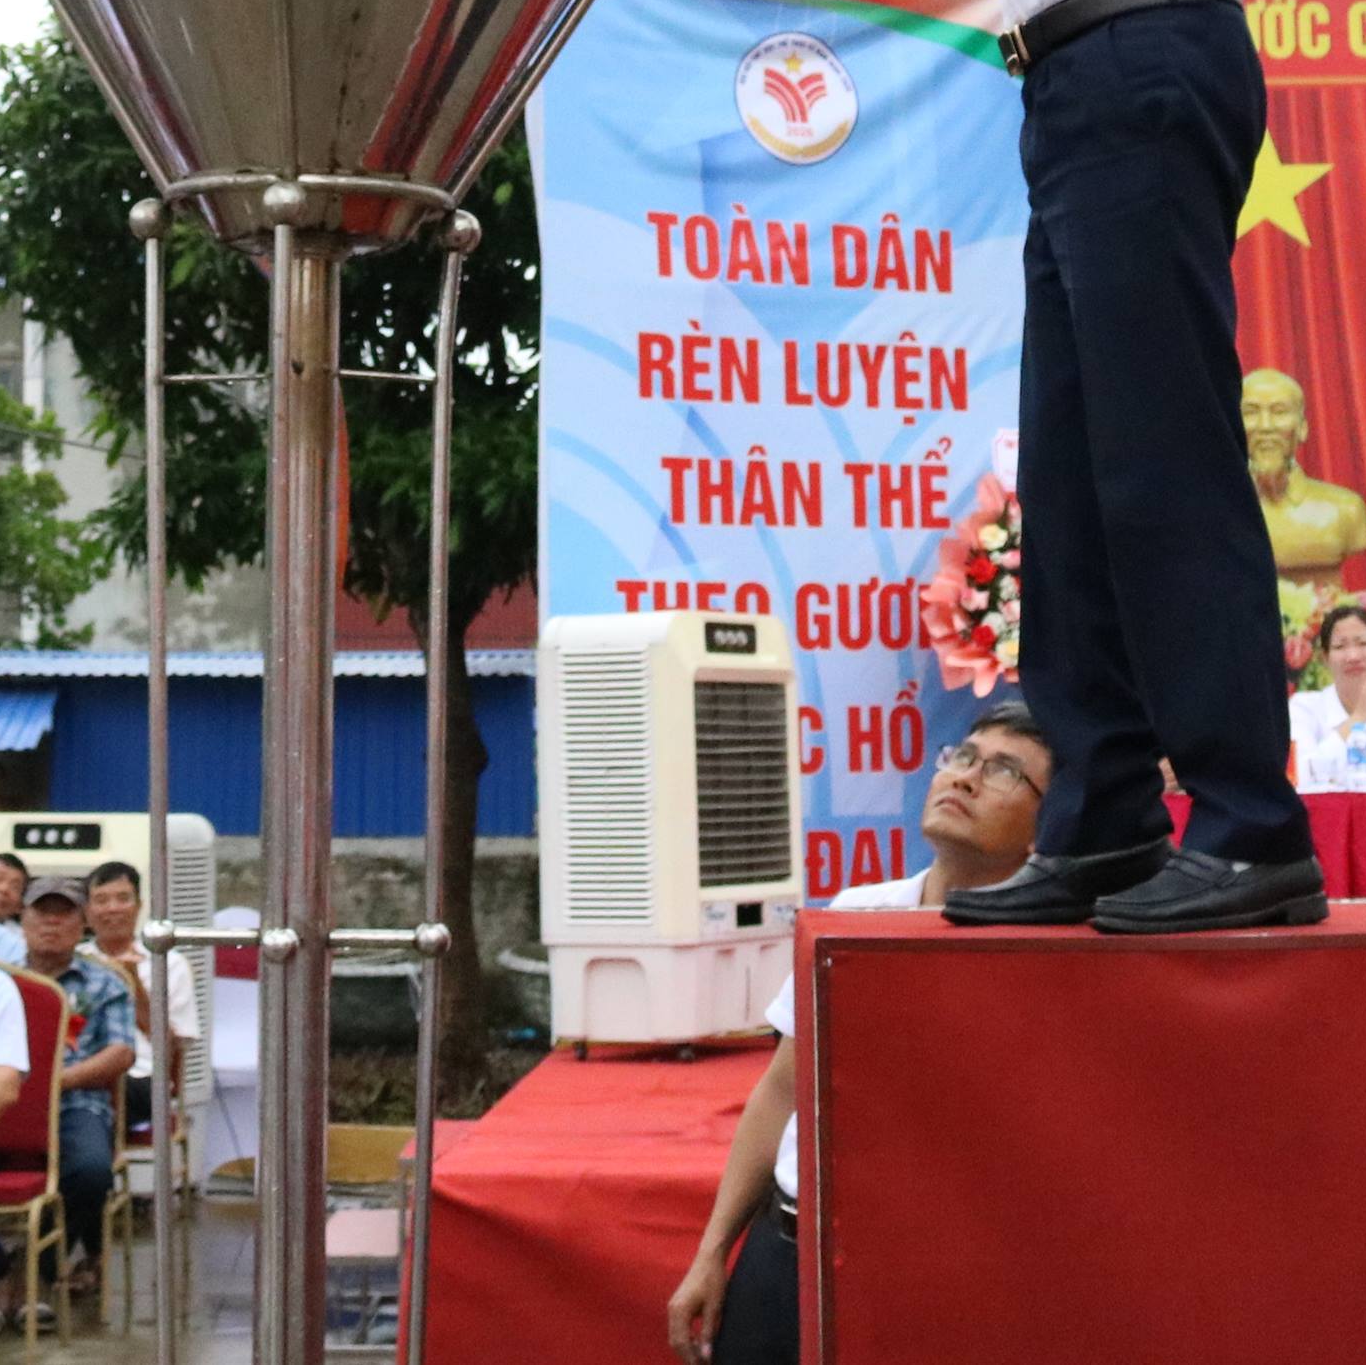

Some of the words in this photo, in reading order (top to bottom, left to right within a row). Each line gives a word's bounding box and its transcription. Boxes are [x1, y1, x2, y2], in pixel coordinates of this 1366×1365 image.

[645, 203, 811, 286] TOÀN
[827, 212, 955, 294] DÂN
[636, 320, 761, 404] RÈN
[783, 330, 969, 426] LUYỆN
[661, 445, 823, 527] THÂN
[844, 437, 953, 529] THỂ
[847, 680, 924, 773] HỒ
